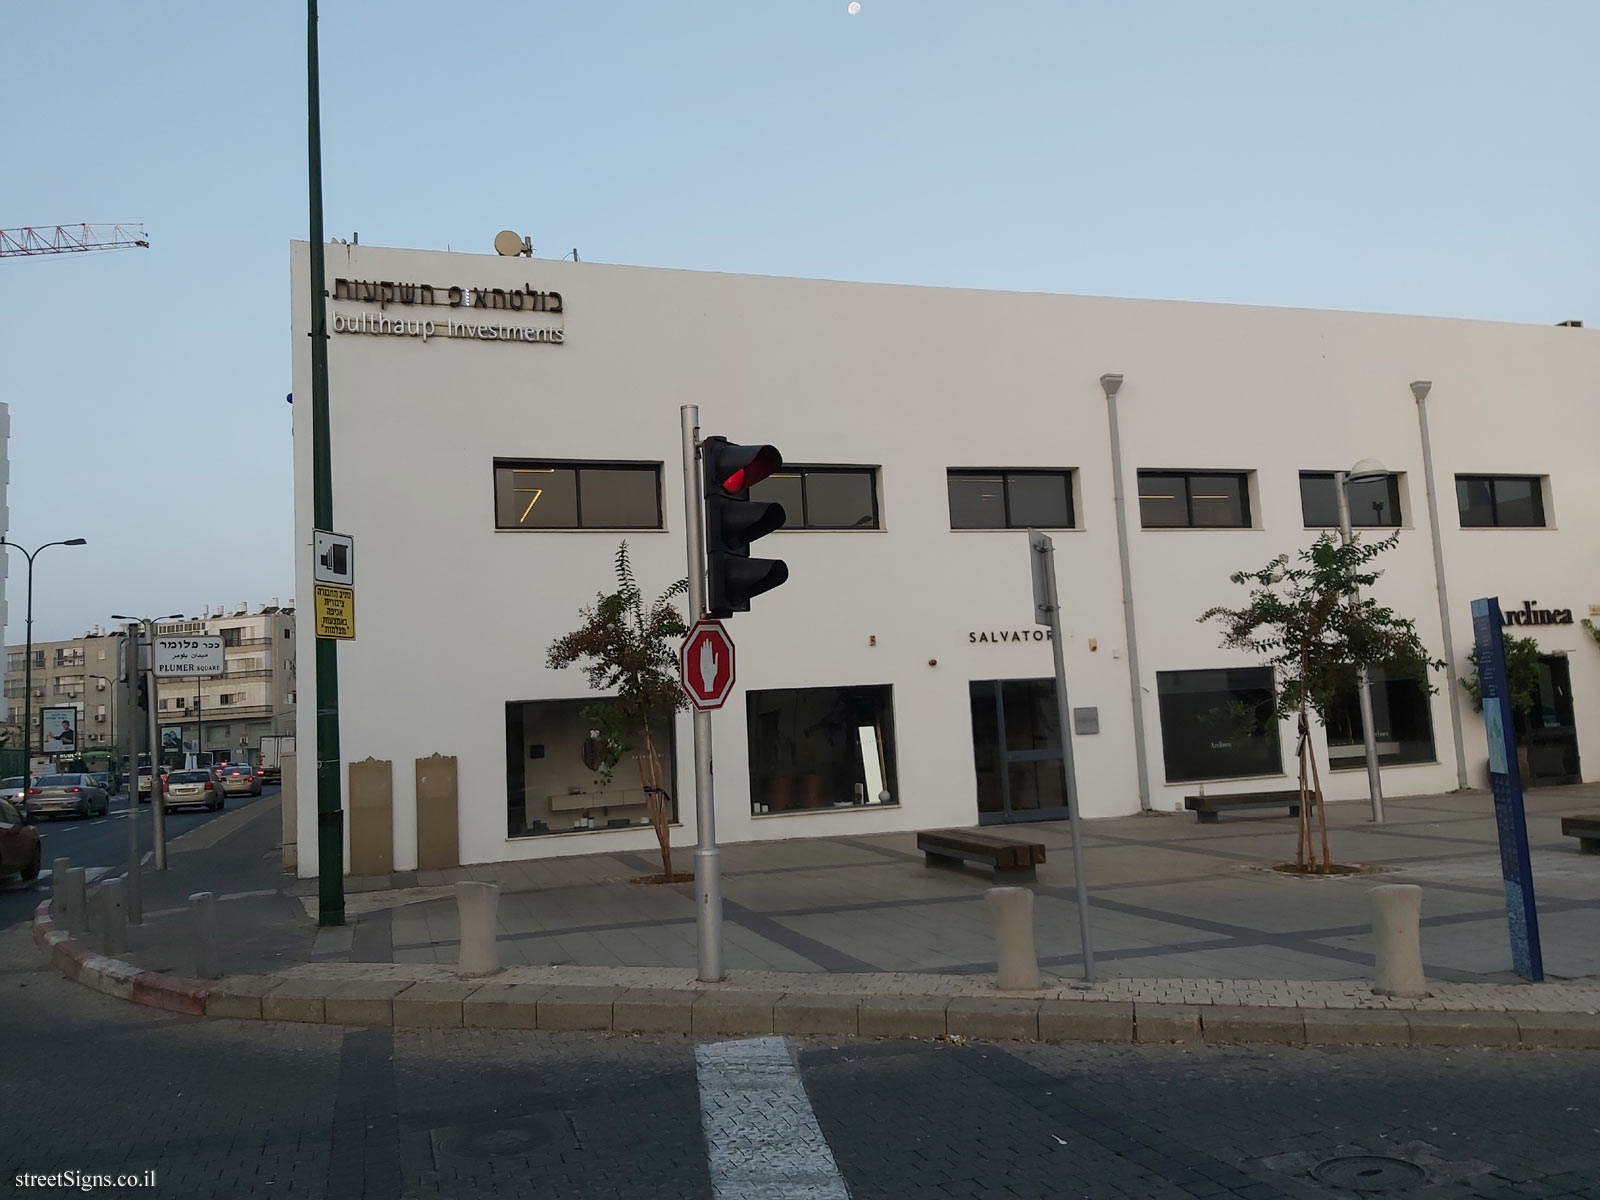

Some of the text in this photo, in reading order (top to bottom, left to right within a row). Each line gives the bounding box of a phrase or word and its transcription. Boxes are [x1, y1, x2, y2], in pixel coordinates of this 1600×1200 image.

[333, 278, 435, 311] השקעות
[332, 310, 565, 343] bulthaup Investments
[326, 607, 343, 617] אכיפה
[1500, 600, 1574, 626] rclinea
[159, 640, 199, 649] פלומר
[159, 664, 195, 672] PLUMER
